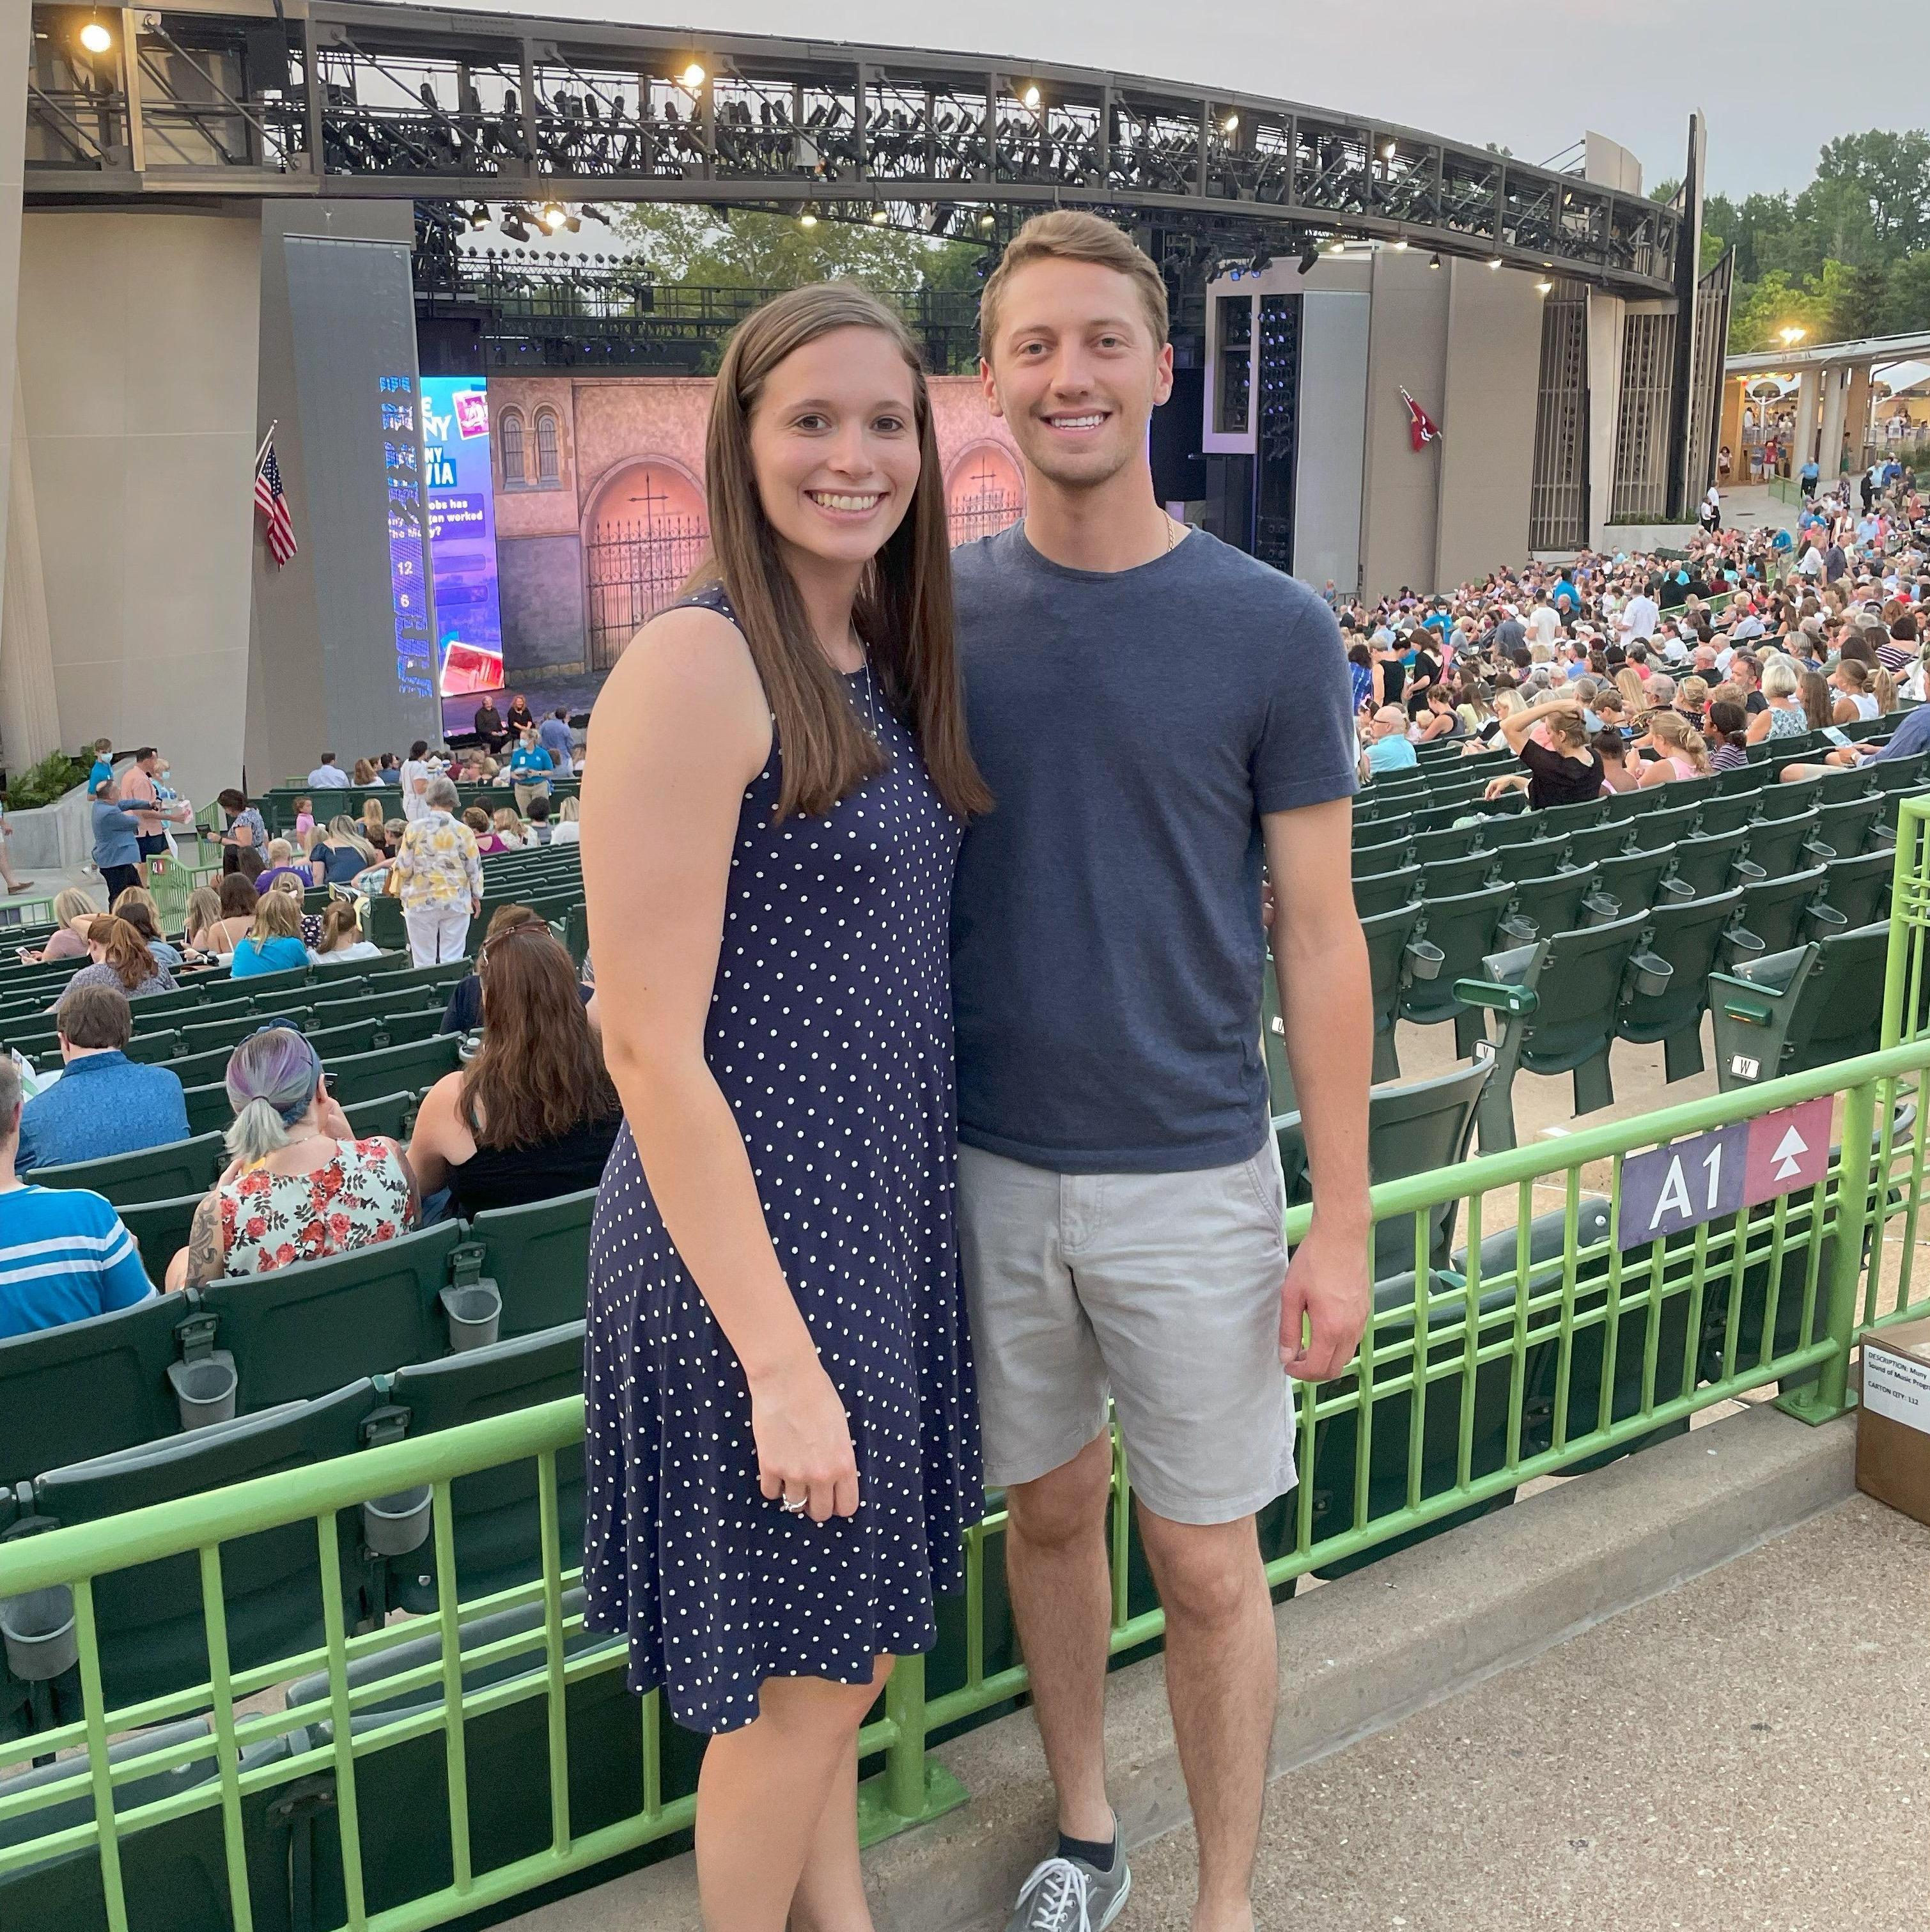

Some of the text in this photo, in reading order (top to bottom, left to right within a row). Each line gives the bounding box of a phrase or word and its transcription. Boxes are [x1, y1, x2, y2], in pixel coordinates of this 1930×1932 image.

[450, 499, 468, 508] has
[447, 510, 483, 522] worked
[398, 561, 413, 575] 12
[1740, 1059, 1750, 1074] W
[1649, 1142, 1722, 1231] A1
[1868, 1362, 1885, 1373] Sound
[1868, 1381, 1891, 1394] CARTON
